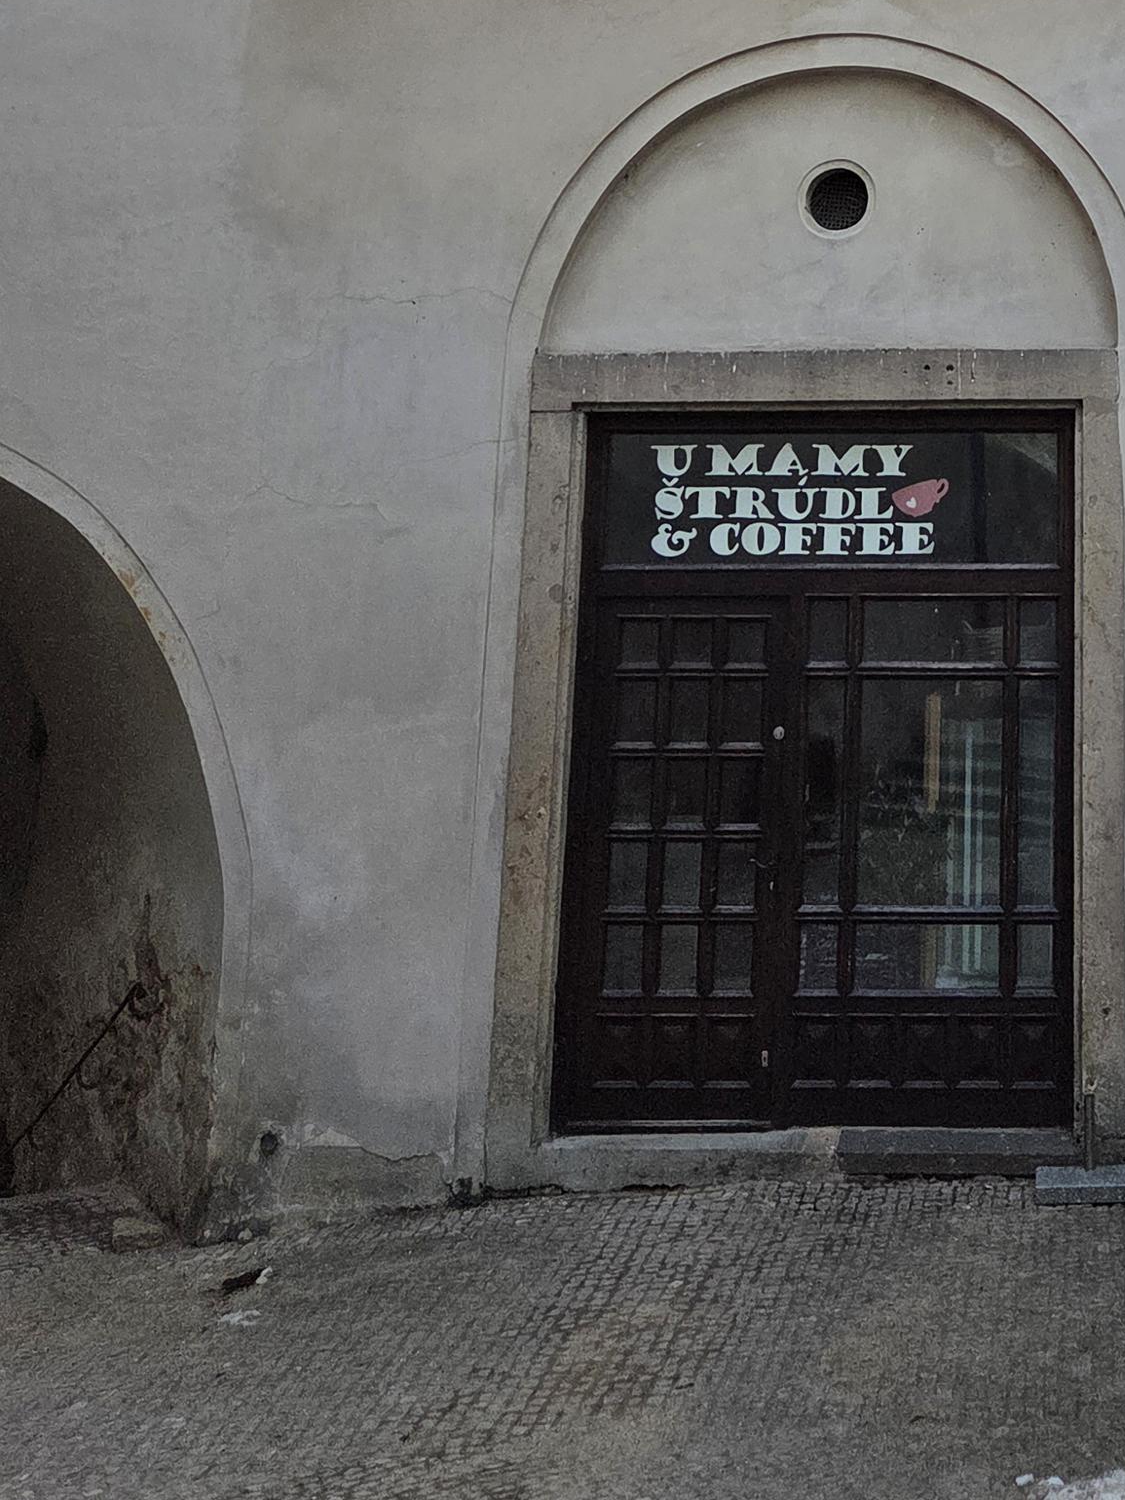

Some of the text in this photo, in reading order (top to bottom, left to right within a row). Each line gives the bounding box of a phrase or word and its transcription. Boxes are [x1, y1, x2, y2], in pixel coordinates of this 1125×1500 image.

[650, 442, 914, 477] U MAMY
[654, 476, 894, 521] ŠTRÚDL
[650, 522, 935, 558] & COFFEE
